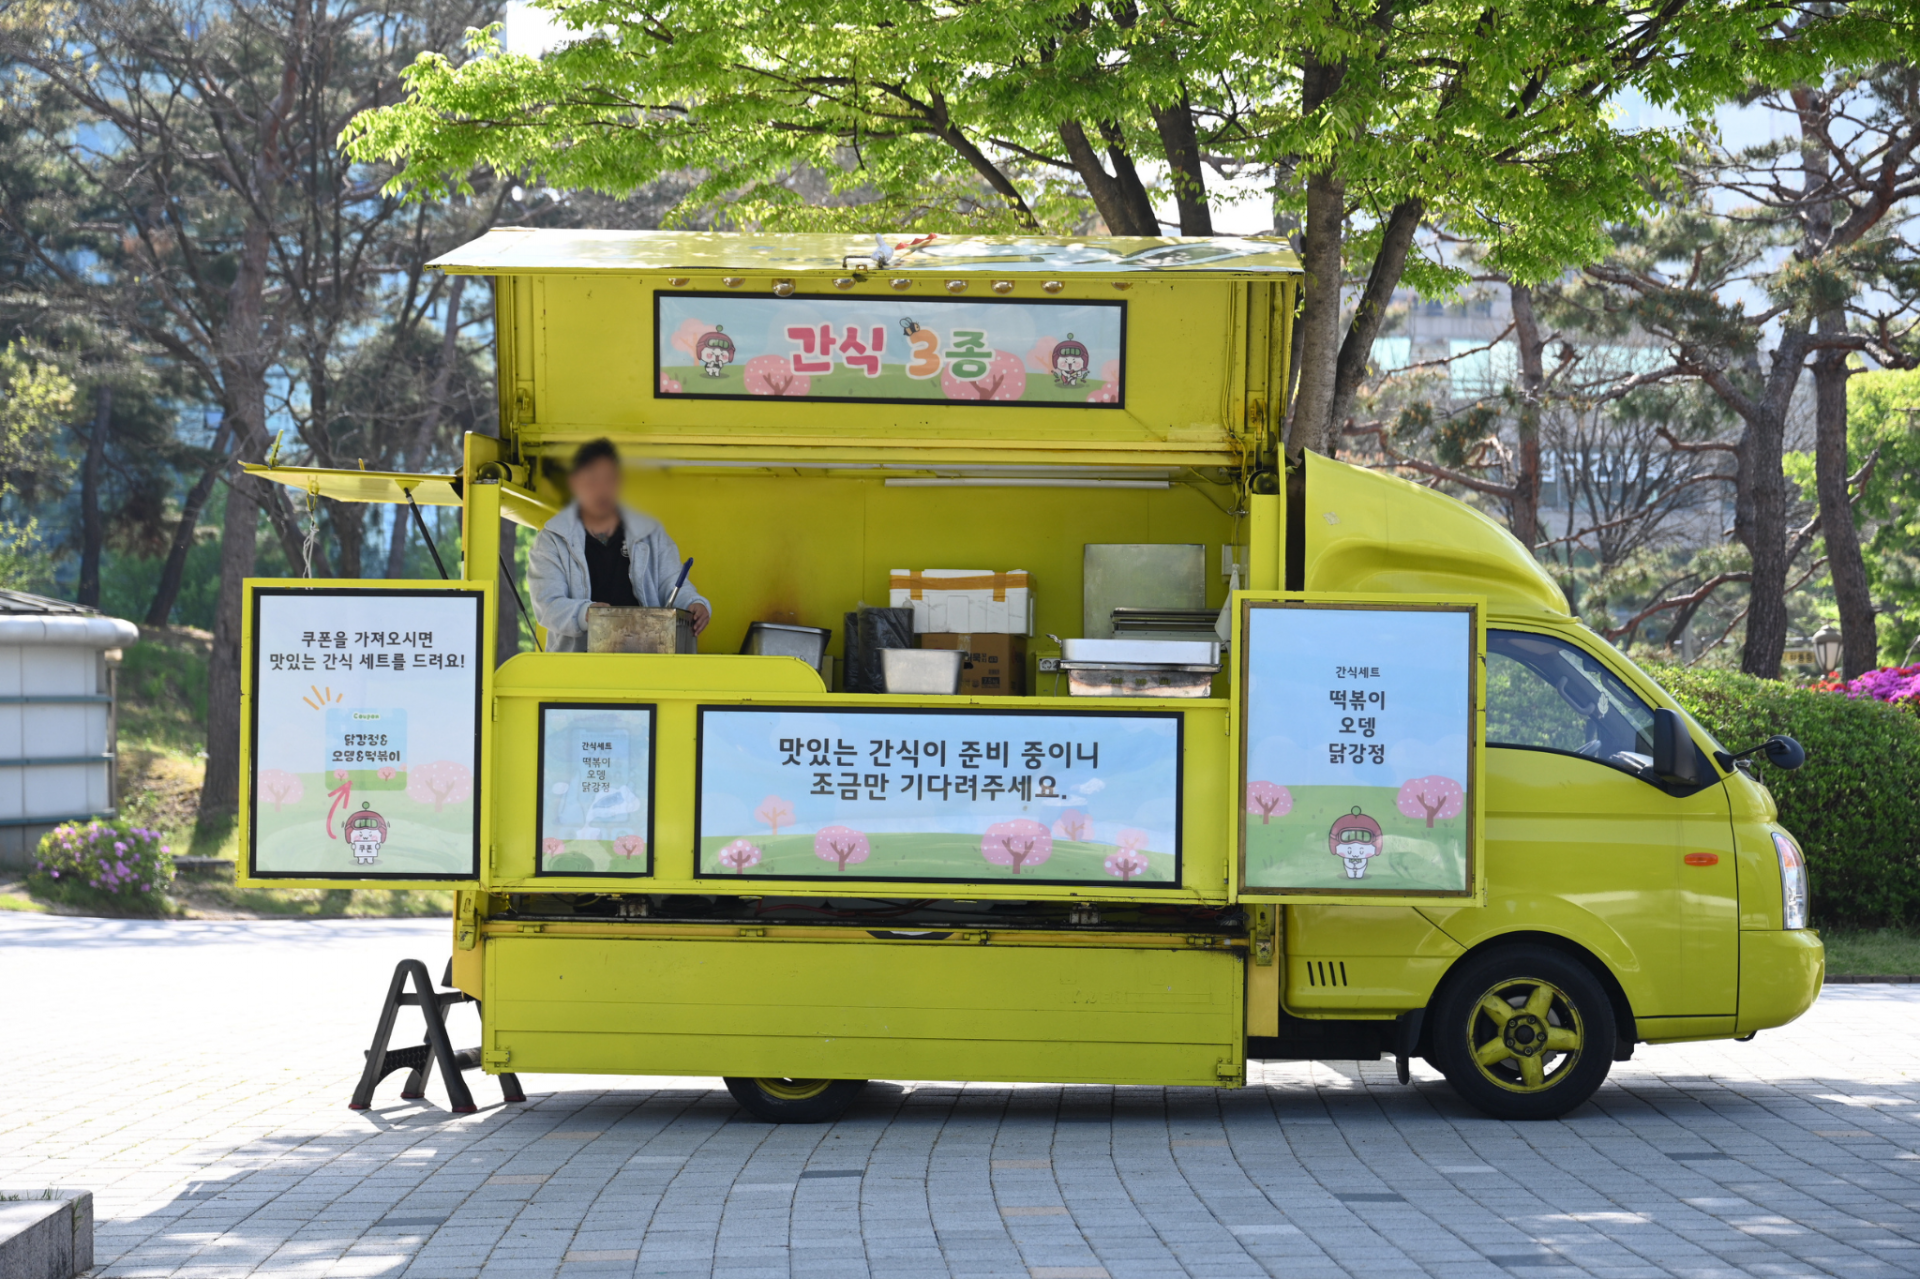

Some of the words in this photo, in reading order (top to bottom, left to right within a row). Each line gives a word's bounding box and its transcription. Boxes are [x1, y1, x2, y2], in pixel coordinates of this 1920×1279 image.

[786, 324, 884, 375] 간식
[908, 329, 993, 379] 3종
[301, 631, 348, 649] 쿠폰을
[354, 631, 433, 649] 가져오시면
[269, 653, 317, 671] 맛있는
[322, 653, 353, 671] 간식
[359, 653, 406, 671] 세트를
[412, 653, 465, 670] 드려요!
[1335, 666, 1381, 679] 간식세트
[1329, 689, 1385, 711] 떡볶이
[353, 712, 380, 721] Coupon
[1338, 716, 1376, 738] 오뎅
[344, 733, 388, 747] 닭강정&
[582, 741, 613, 751] 간식세트
[332, 749, 401, 763] 오뎅&떡볶이
[779, 737, 858, 767] 맛있는
[869, 739, 946, 769] 간식이
[958, 740, 1009, 769] 준비
[1020, 741, 1099, 770] 중이니
[1328, 742, 1385, 765] 닭강정
[582, 756, 611, 768] 떡볶이
[587, 769, 606, 781] 오뎅
[581, 781, 611, 793] 닭강정
[810, 772, 890, 801] 조금만
[900, 773, 1067, 802] 기다려주세요.
[359, 844, 373, 854] 쿠폰
